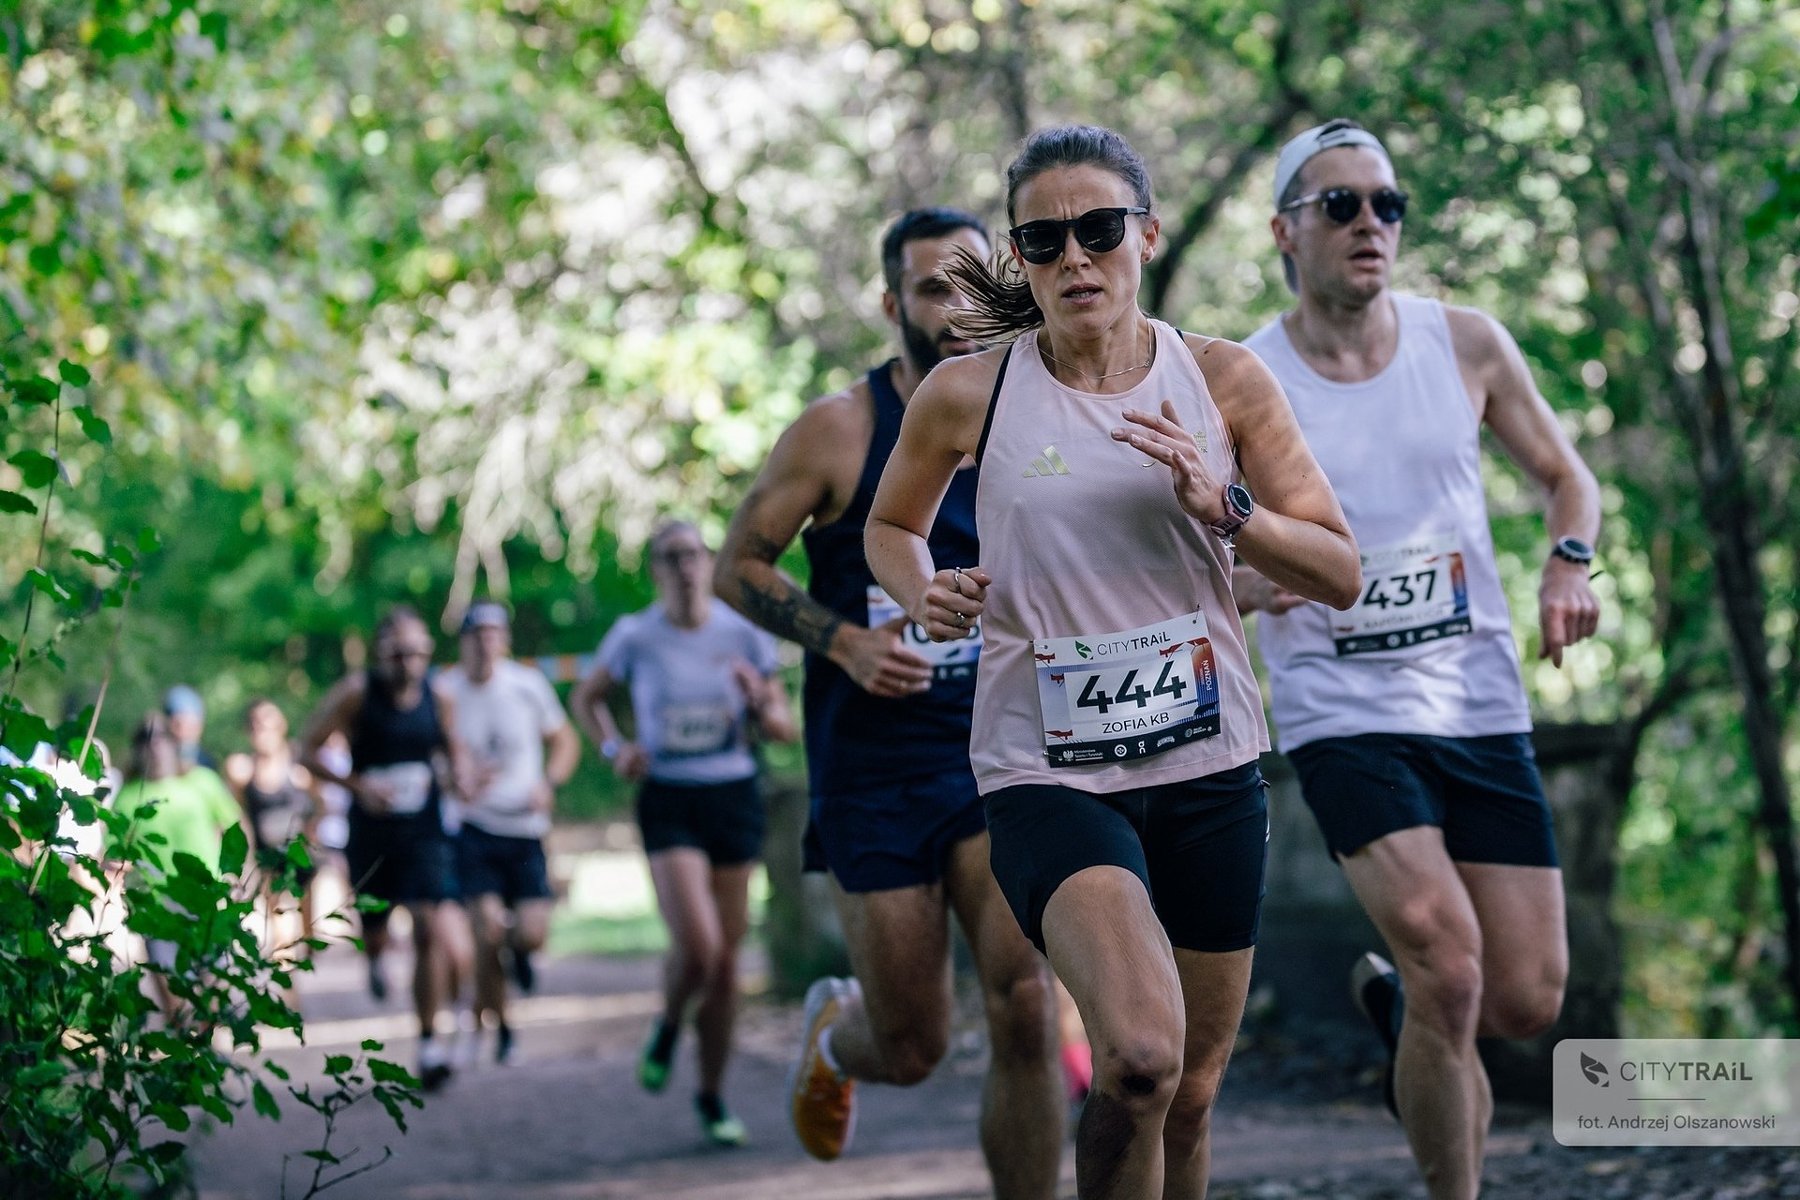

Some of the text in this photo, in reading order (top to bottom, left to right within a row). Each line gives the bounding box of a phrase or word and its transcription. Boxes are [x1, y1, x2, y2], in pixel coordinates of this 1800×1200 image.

[1362, 569, 1437, 609] 437
[1076, 660, 1187, 714] 444
[1202, 659, 1212, 691] POZNAŃ
[1102, 712, 1170, 734] ZOFIA KB
